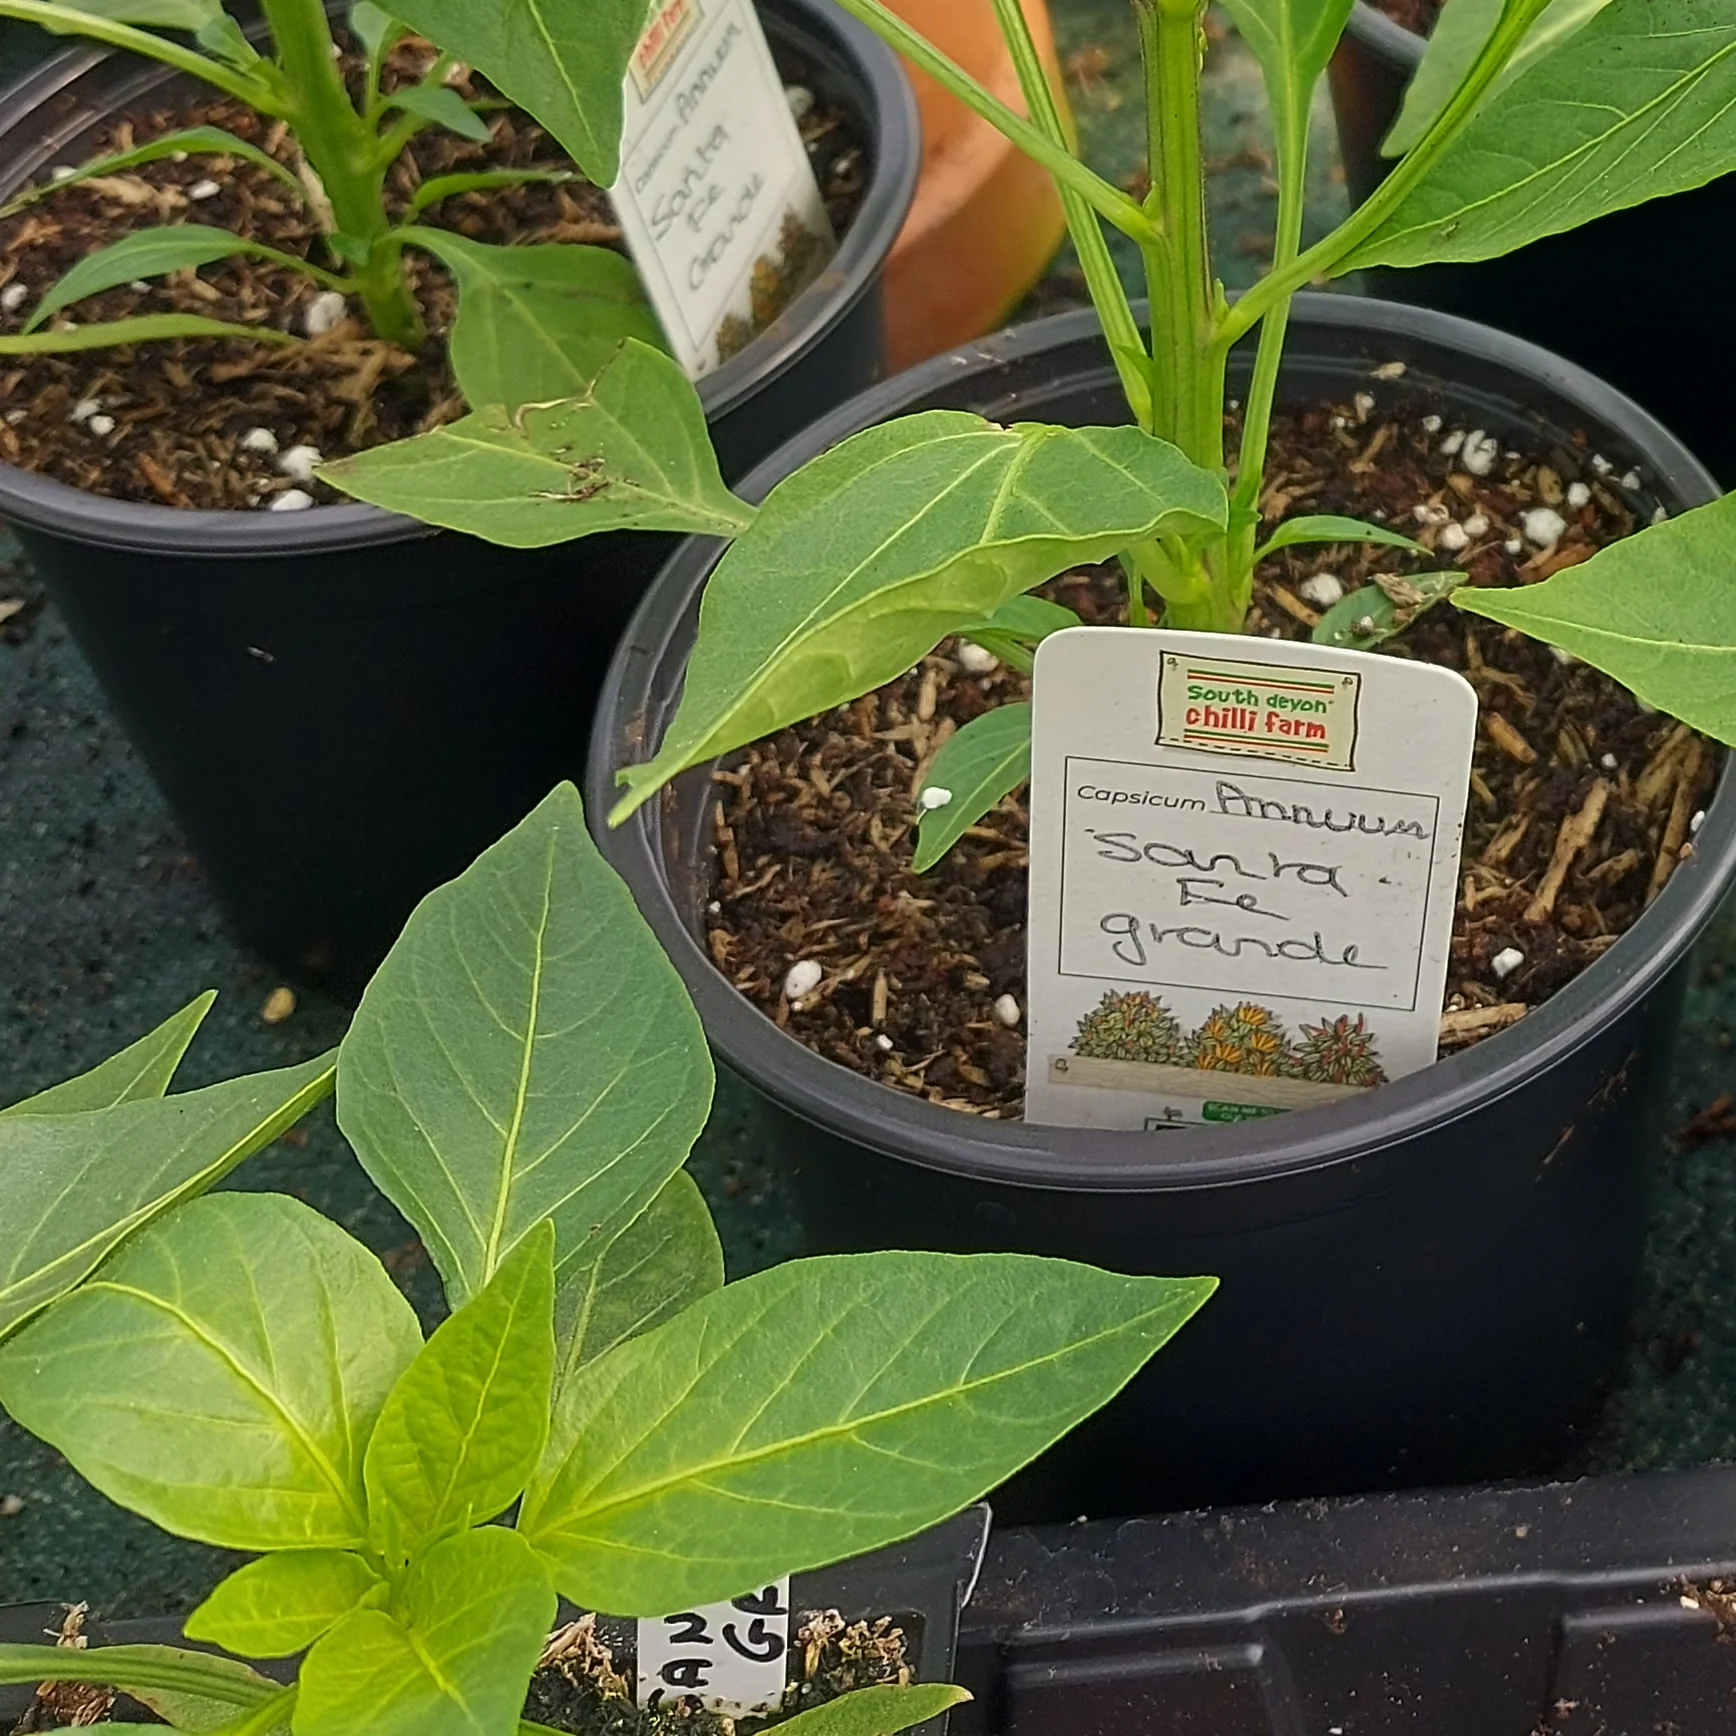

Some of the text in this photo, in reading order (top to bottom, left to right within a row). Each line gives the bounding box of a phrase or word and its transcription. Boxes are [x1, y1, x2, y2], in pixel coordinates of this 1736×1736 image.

[1265, 693, 1328, 714] devon
[1185, 704, 1327, 740] chilli farm
[1077, 784, 1207, 812] Capsicum
